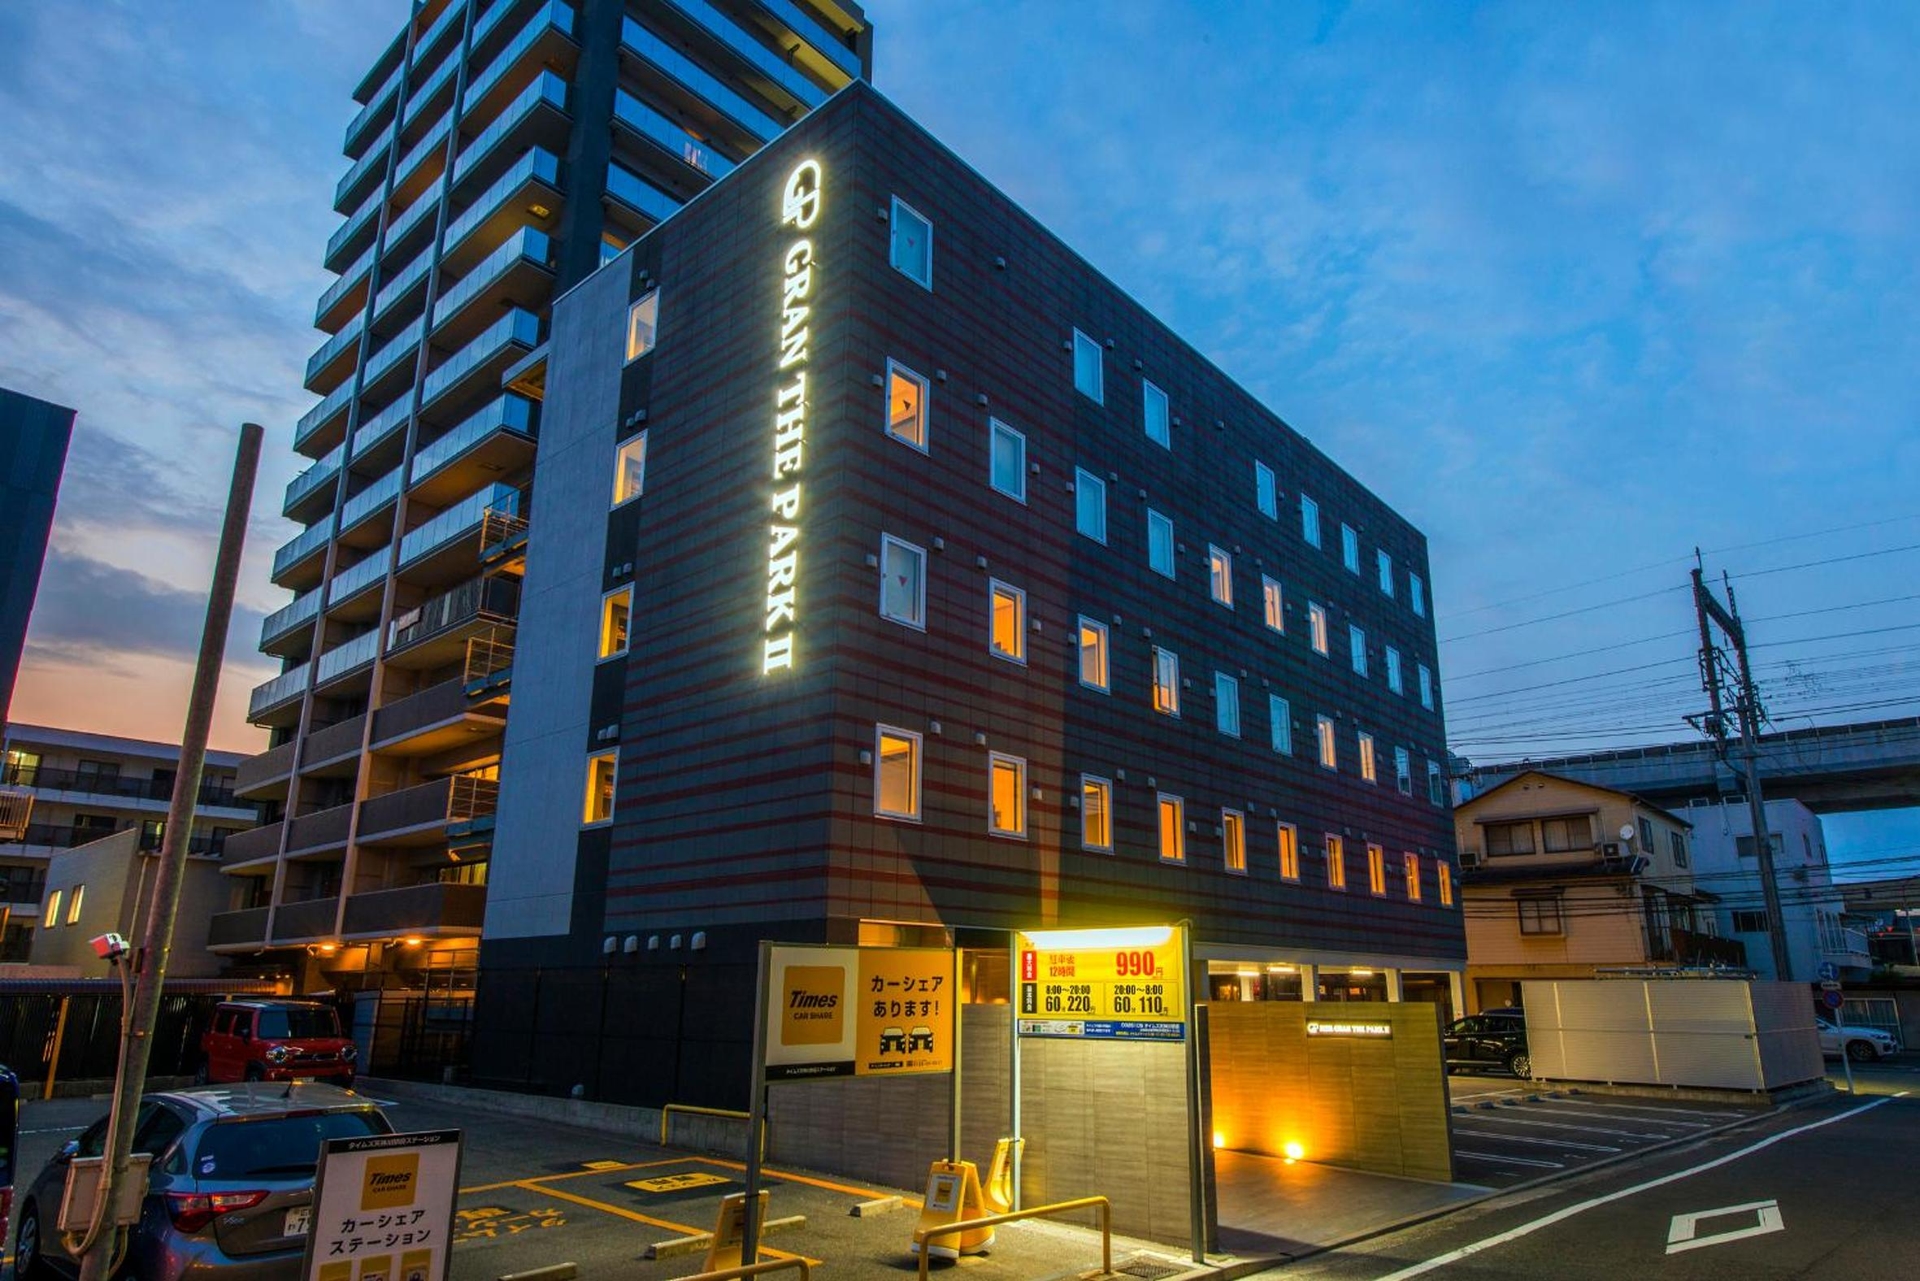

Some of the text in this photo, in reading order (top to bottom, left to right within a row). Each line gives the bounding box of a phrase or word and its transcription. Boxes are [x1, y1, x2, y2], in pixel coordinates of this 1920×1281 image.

[763, 239, 813, 676] GRAN THE PARK II
[871, 975, 944, 993] カーシェア
[790, 990, 838, 1008] Times
[793, 1011, 833, 1020] CAR SHARE
[370, 1172, 412, 1185] Times
[341, 1210, 426, 1234] カーシェア
[330, 1230, 432, 1256] ステーション
